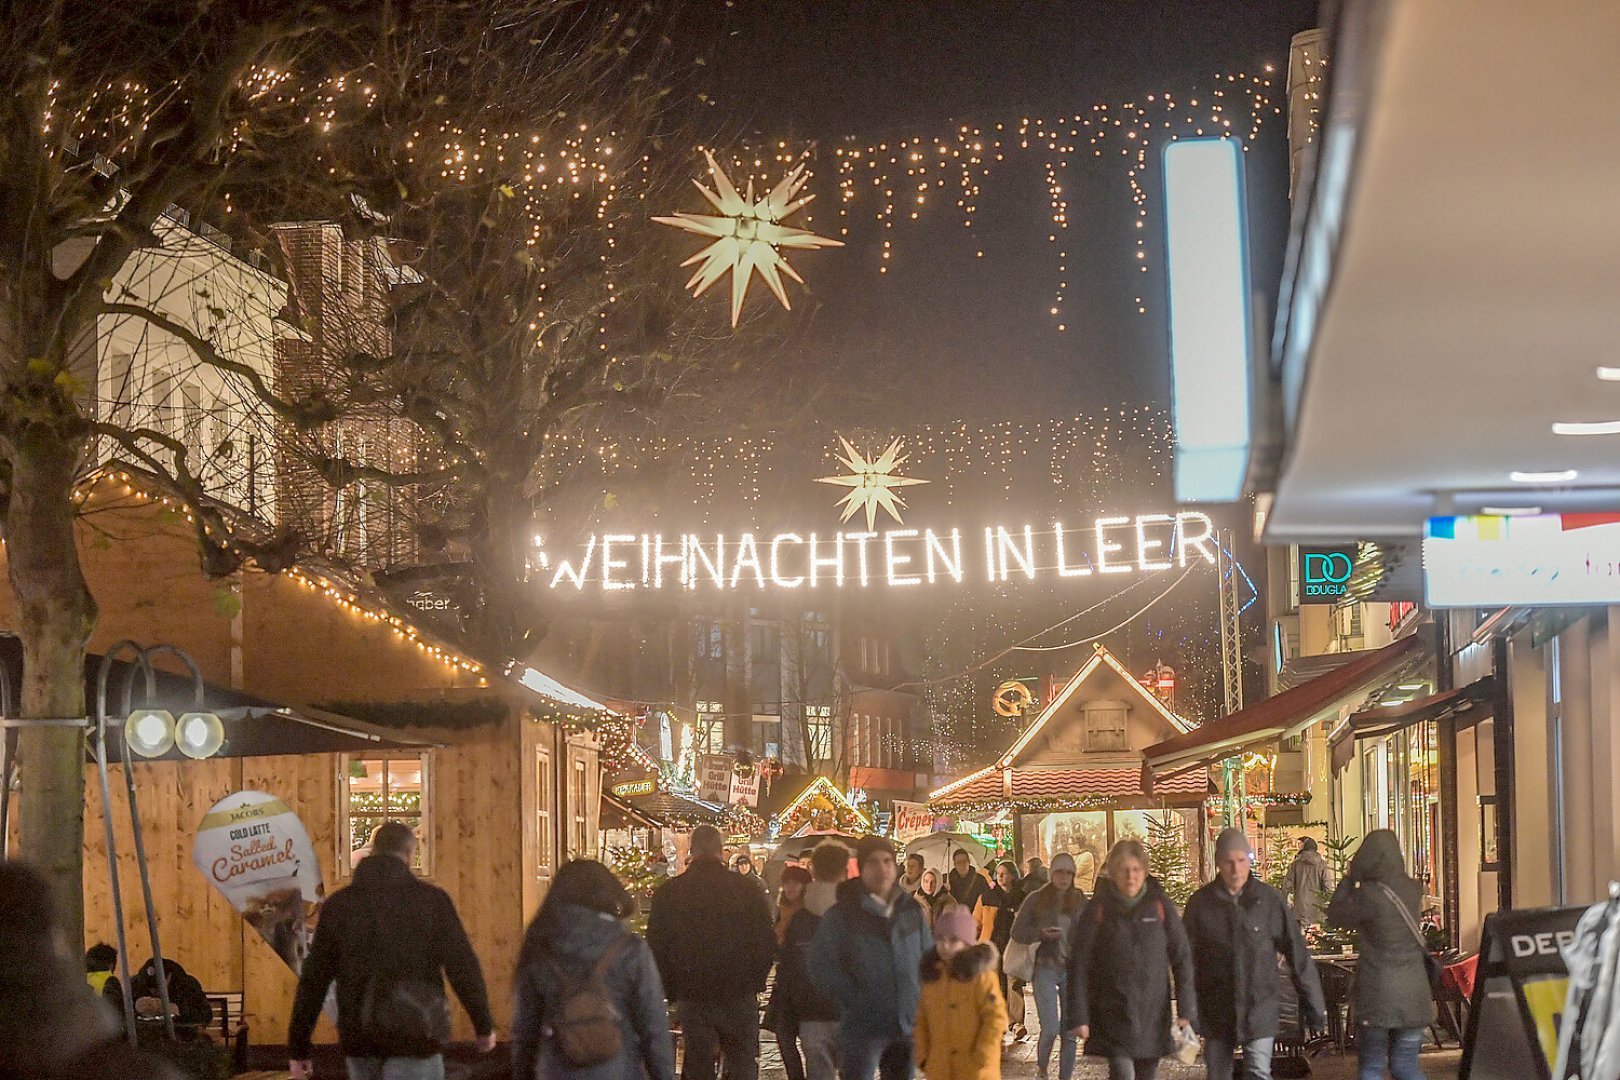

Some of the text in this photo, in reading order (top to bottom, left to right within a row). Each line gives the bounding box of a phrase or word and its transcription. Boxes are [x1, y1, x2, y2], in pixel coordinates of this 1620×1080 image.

[534, 511, 1216, 590] WEIHNACHTEN IN LEER
[703, 780, 728, 791] Hütte
[732, 784, 757, 796] Hütte
[230, 808, 265, 822] JACOBS
[229, 822, 271, 841] COLD LATTE
[230, 836, 278, 862] Salted
[211, 838, 296, 883] Caramel
